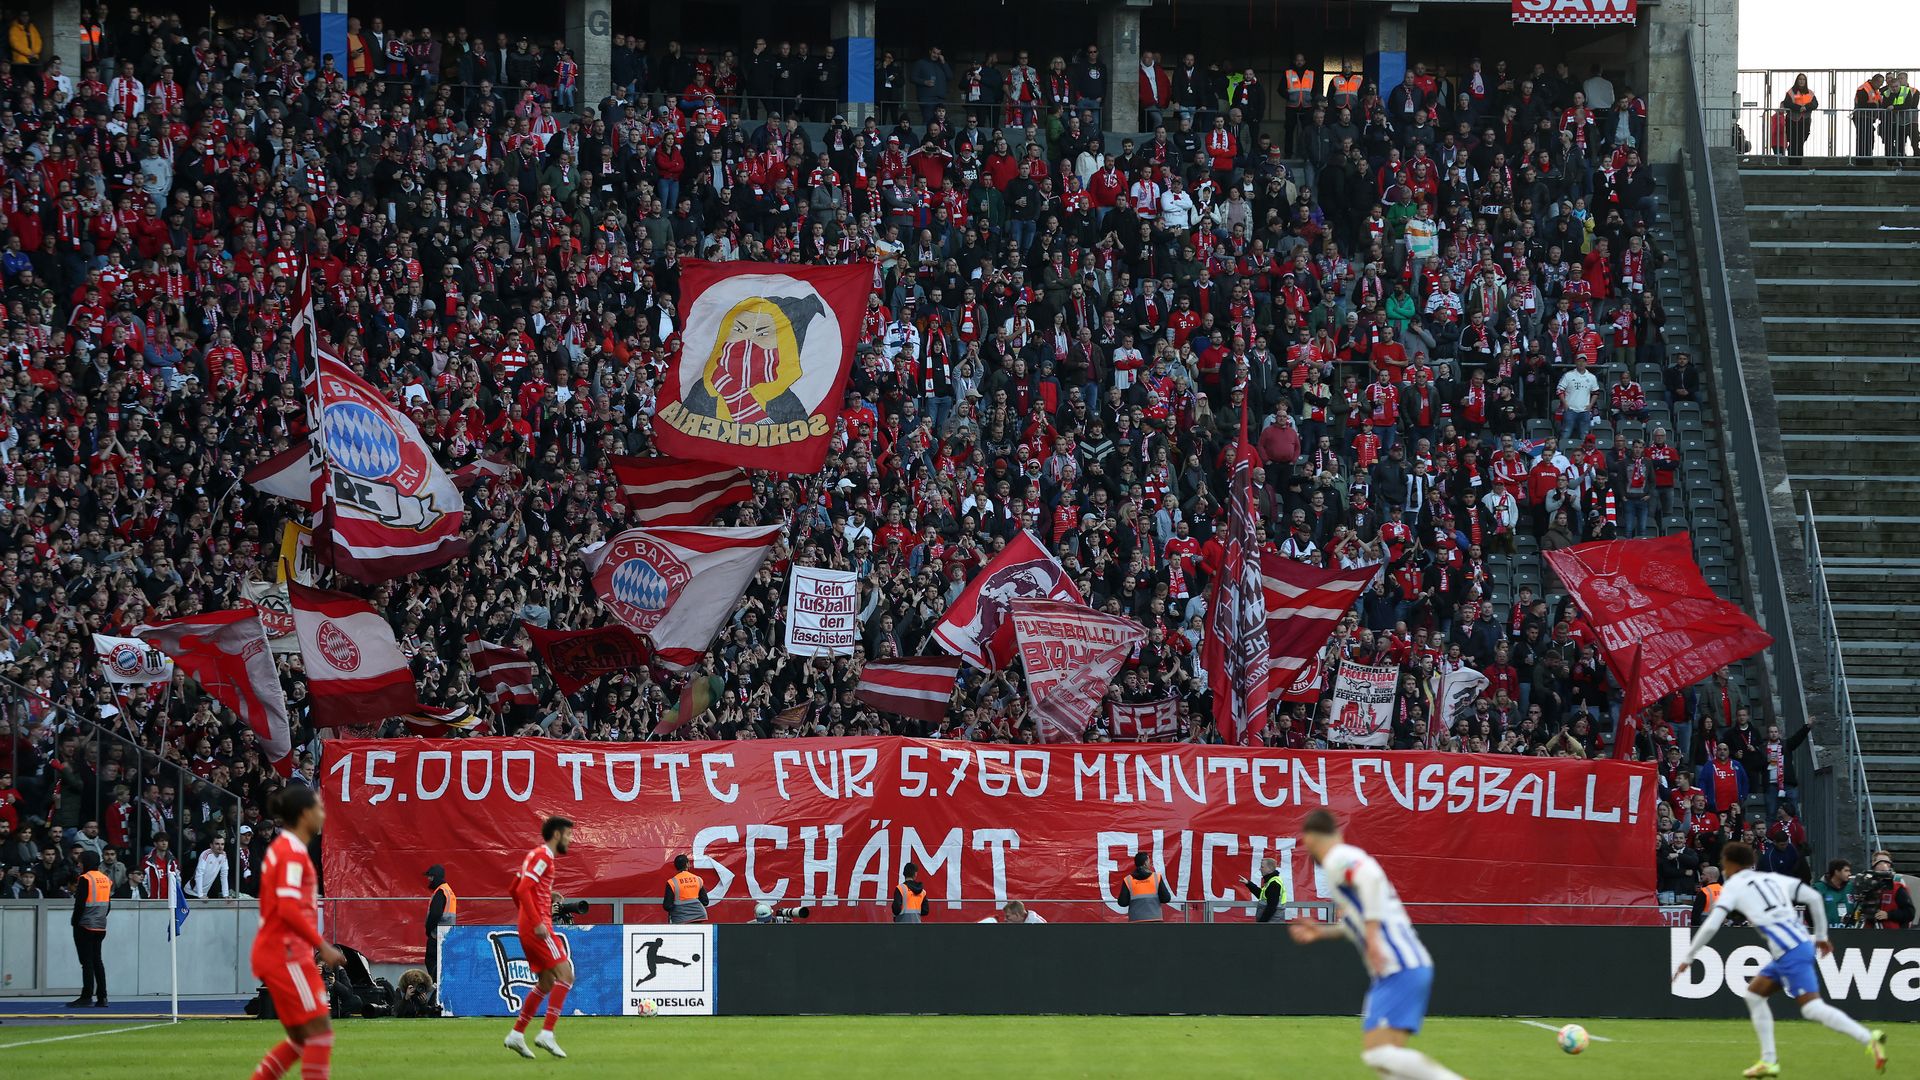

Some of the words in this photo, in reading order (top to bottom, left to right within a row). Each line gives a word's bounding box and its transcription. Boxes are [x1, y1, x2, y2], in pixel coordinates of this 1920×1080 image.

[588, 10, 609, 36] G
[635, 541, 687, 592] BAYER
[815, 580, 844, 596] kein
[799, 593, 852, 613] fußball
[819, 614, 845, 629] den
[793, 629, 852, 644] faschisten
[1339, 667, 1397, 682] PROLETARIAT
[1112, 701, 1177, 736] FCB
[330, 749, 535, 806] 15.000
[556, 750, 741, 805] TOTE
[772, 747, 878, 800] FÜR
[900, 746, 1051, 800] 5.760
[1073, 752, 1329, 808] MINUTEN
[1352, 757, 1643, 824] FUSSBALL!
[691, 817, 1021, 910] SCHÄMT
[1747, 878, 1788, 912] 10
